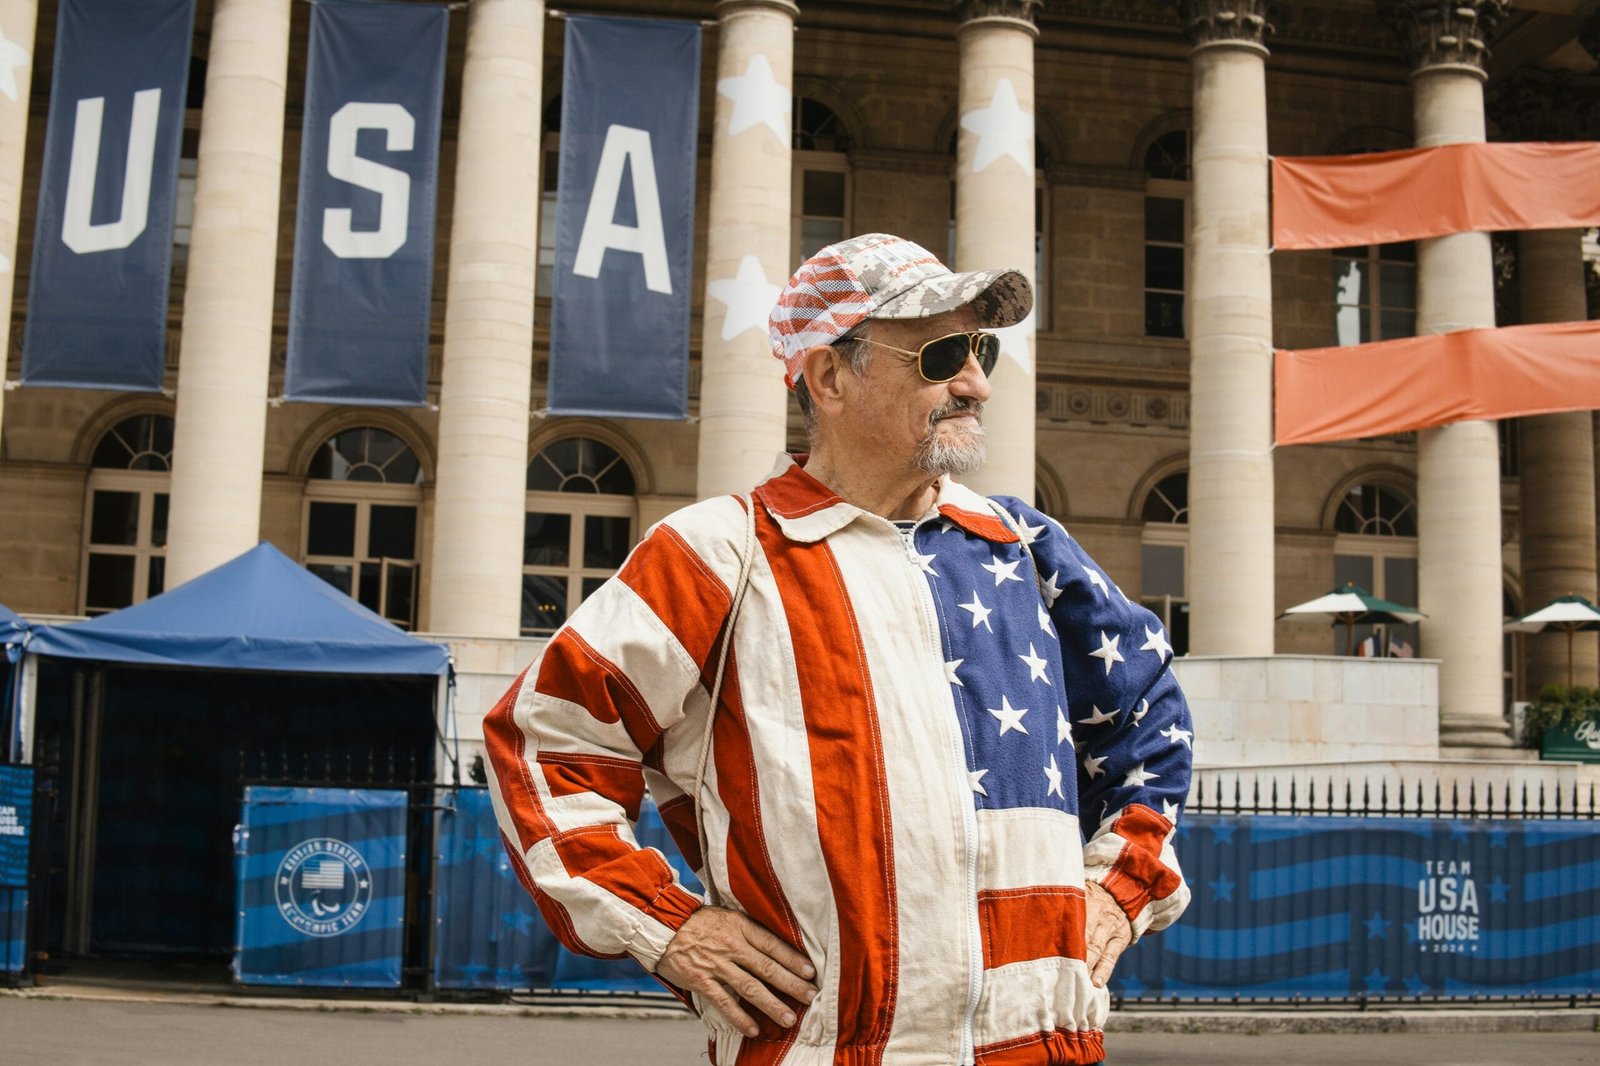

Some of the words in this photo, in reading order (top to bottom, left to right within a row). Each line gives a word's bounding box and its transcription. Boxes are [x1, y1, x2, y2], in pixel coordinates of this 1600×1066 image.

[61, 87, 162, 254] U
[322, 102, 416, 259] S
[572, 124, 674, 295] A
[325, 841, 362, 869] STATES
[1425, 860, 1471, 875] TEAM
[1418, 877, 1479, 914] USA
[341, 902, 364, 926] TEAM
[1418, 914, 1479, 940] HOUSE
[1433, 943, 1465, 953] 2024
